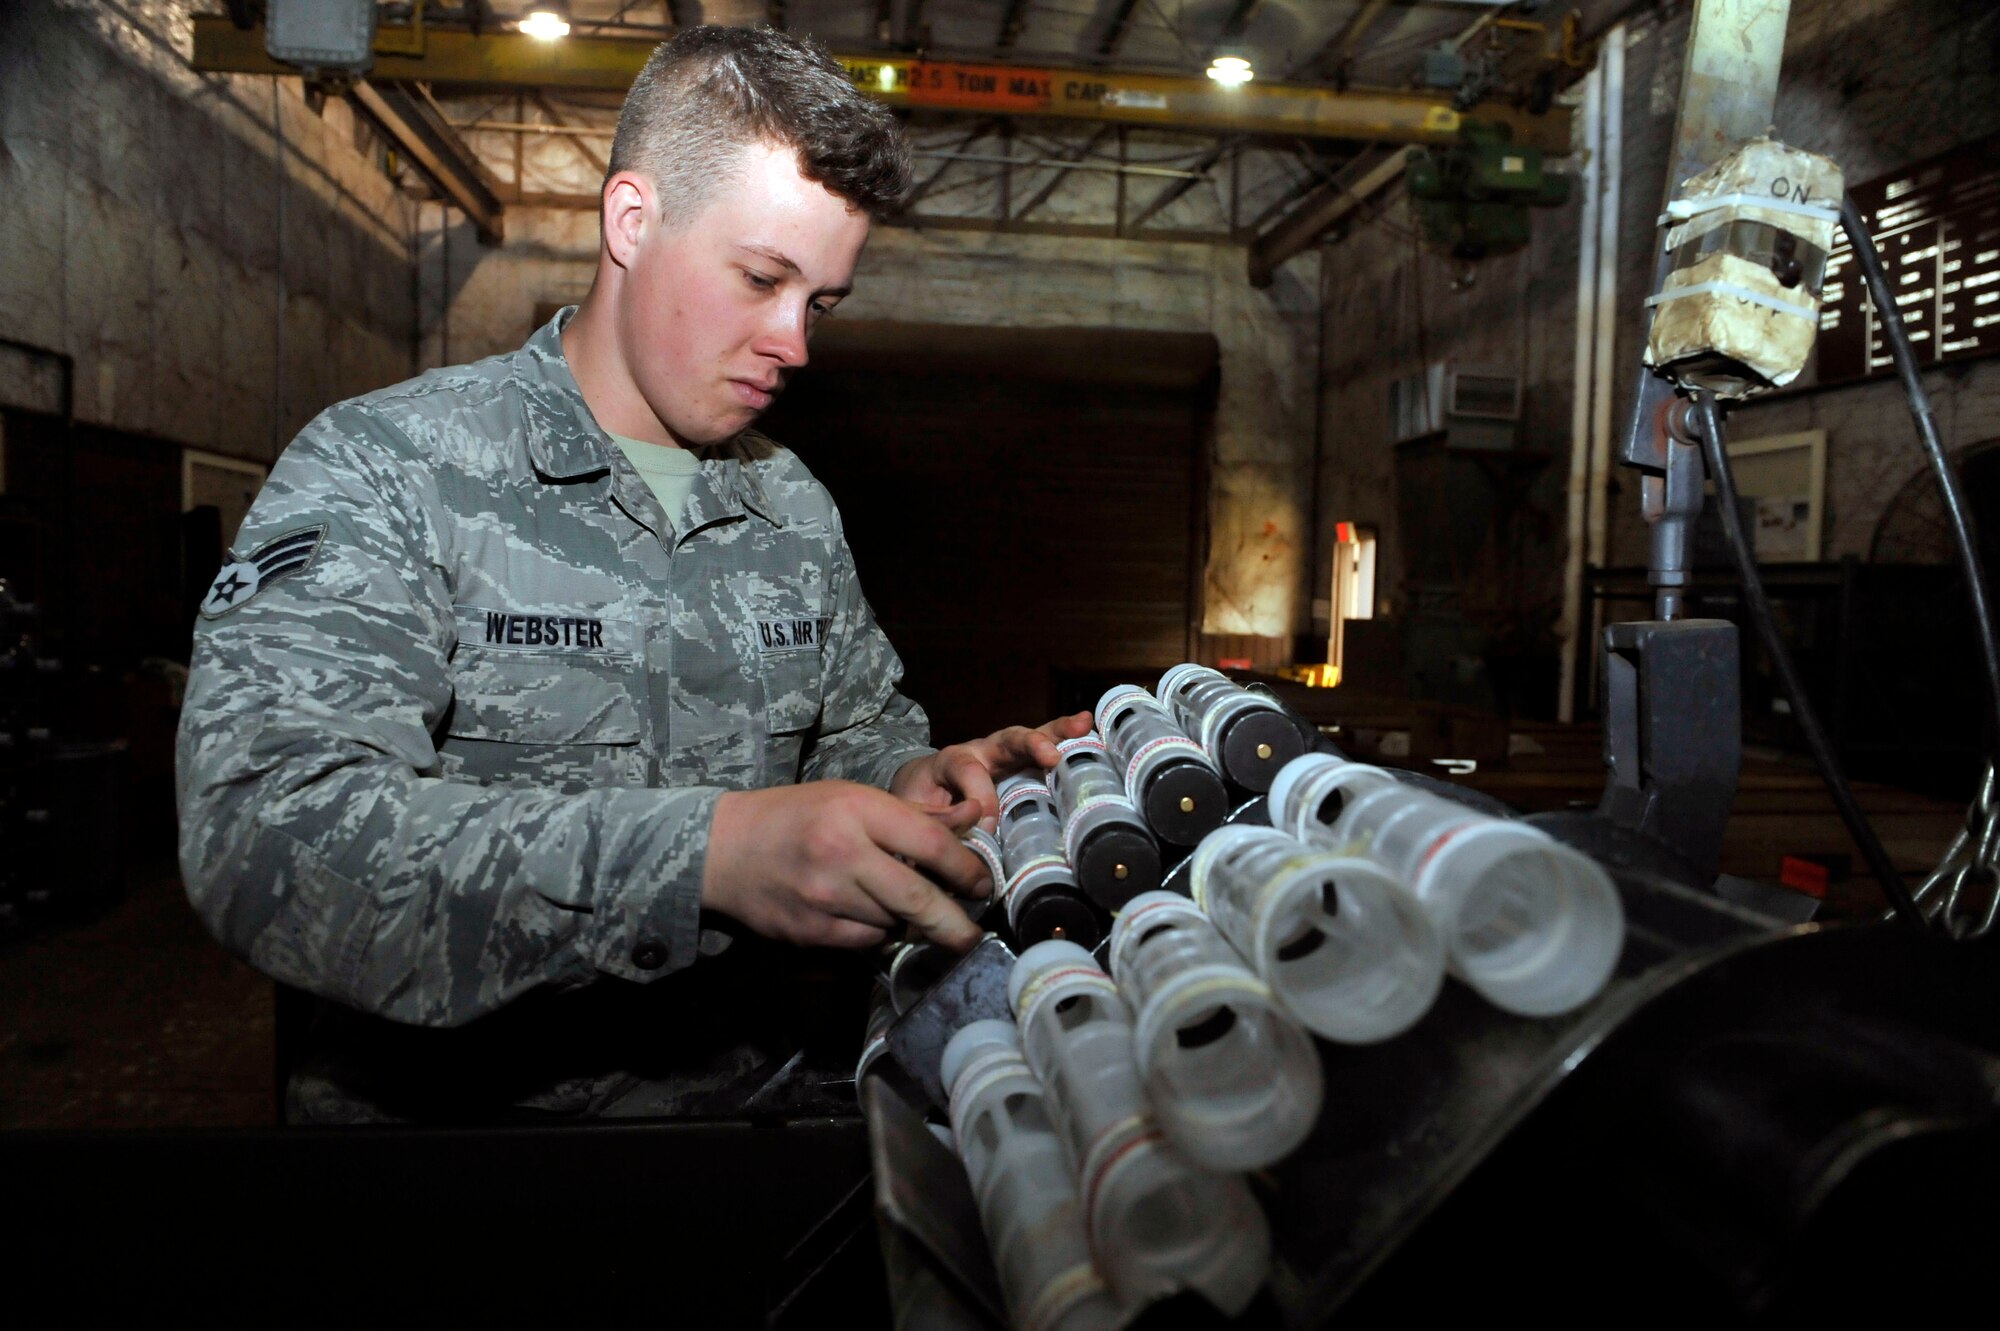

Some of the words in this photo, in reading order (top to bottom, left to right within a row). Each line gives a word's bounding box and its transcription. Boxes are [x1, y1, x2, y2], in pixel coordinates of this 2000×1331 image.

[956, 72, 996, 92] TON
[1009, 76, 1052, 97] MAX
[1771, 176, 1812, 205] ON
[486, 611, 604, 648] WEBSTER
[760, 621, 790, 648] U.S.
